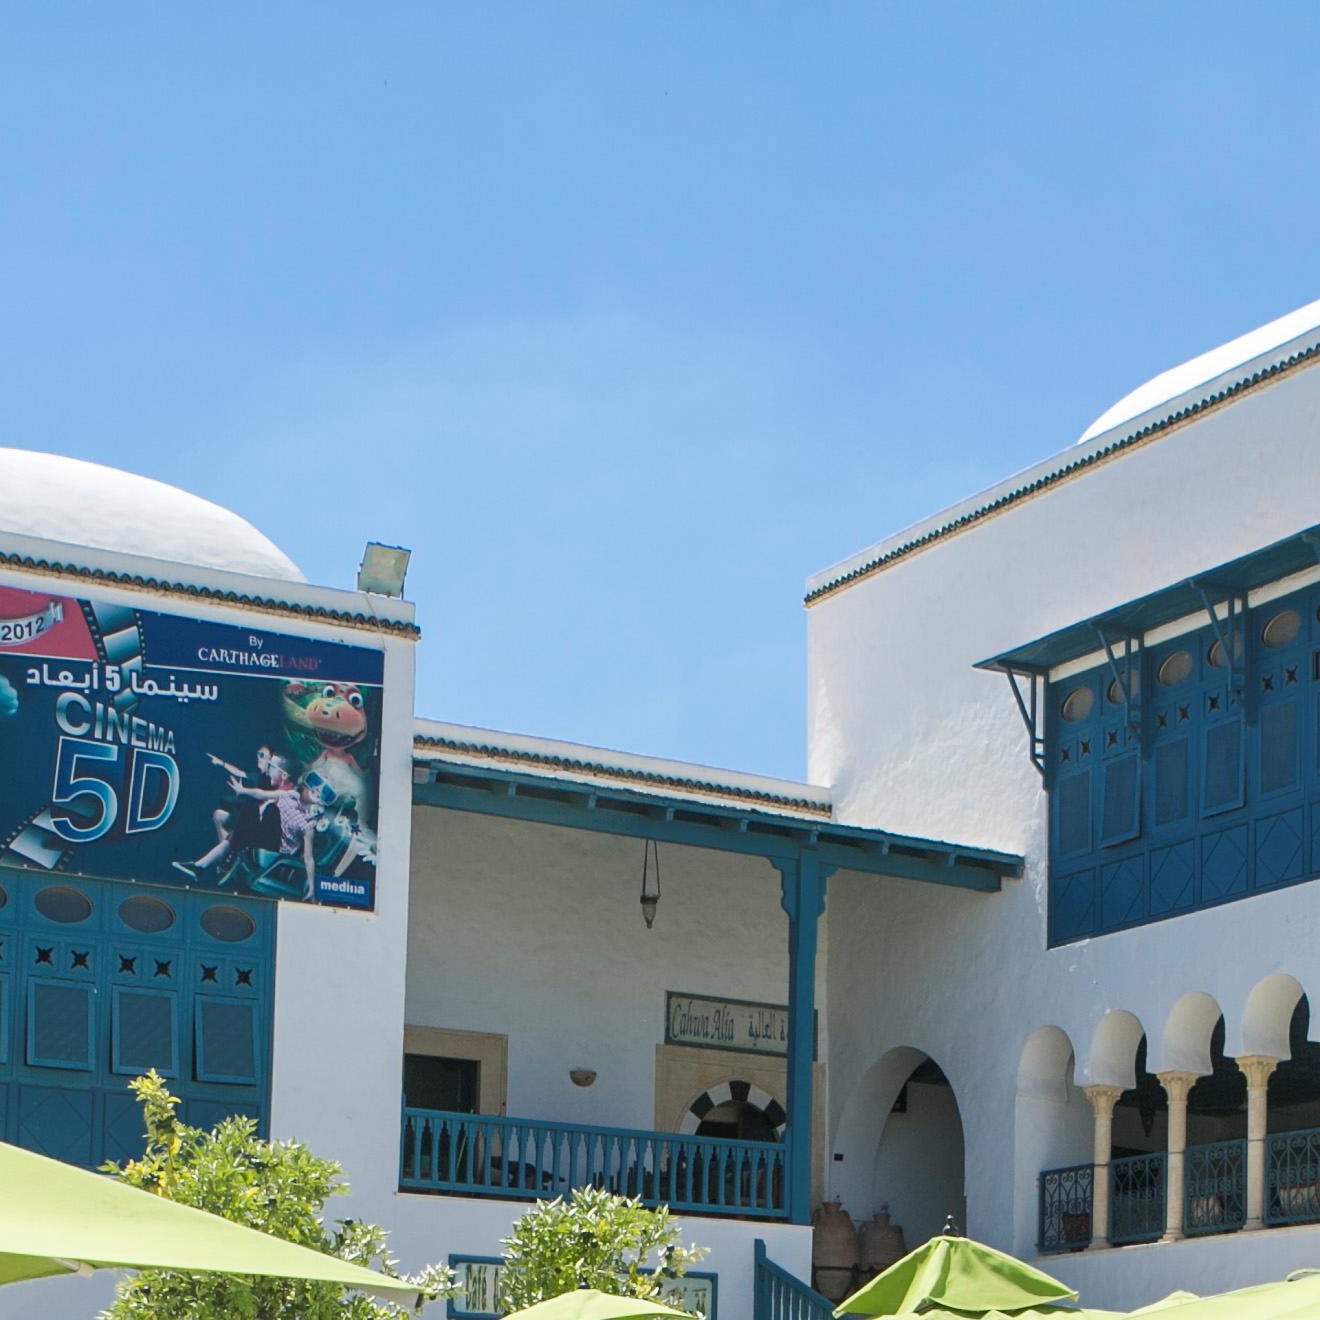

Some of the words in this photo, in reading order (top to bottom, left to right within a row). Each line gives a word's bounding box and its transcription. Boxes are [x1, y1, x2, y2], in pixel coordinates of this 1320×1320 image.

[0, 615, 47, 643] 2012
[248, 635, 264, 650] By
[26, 661, 99, 694] أبعاد
[105, 664, 121, 692] 5
[131, 669, 219, 703] سينما
[55, 691, 177, 755] CINEMA
[50, 735, 181, 843] 5D
[320, 880, 366, 895] medina
[671, 1000, 710, 1039] Cahwa
[710, 1005, 735, 1041] Alia
